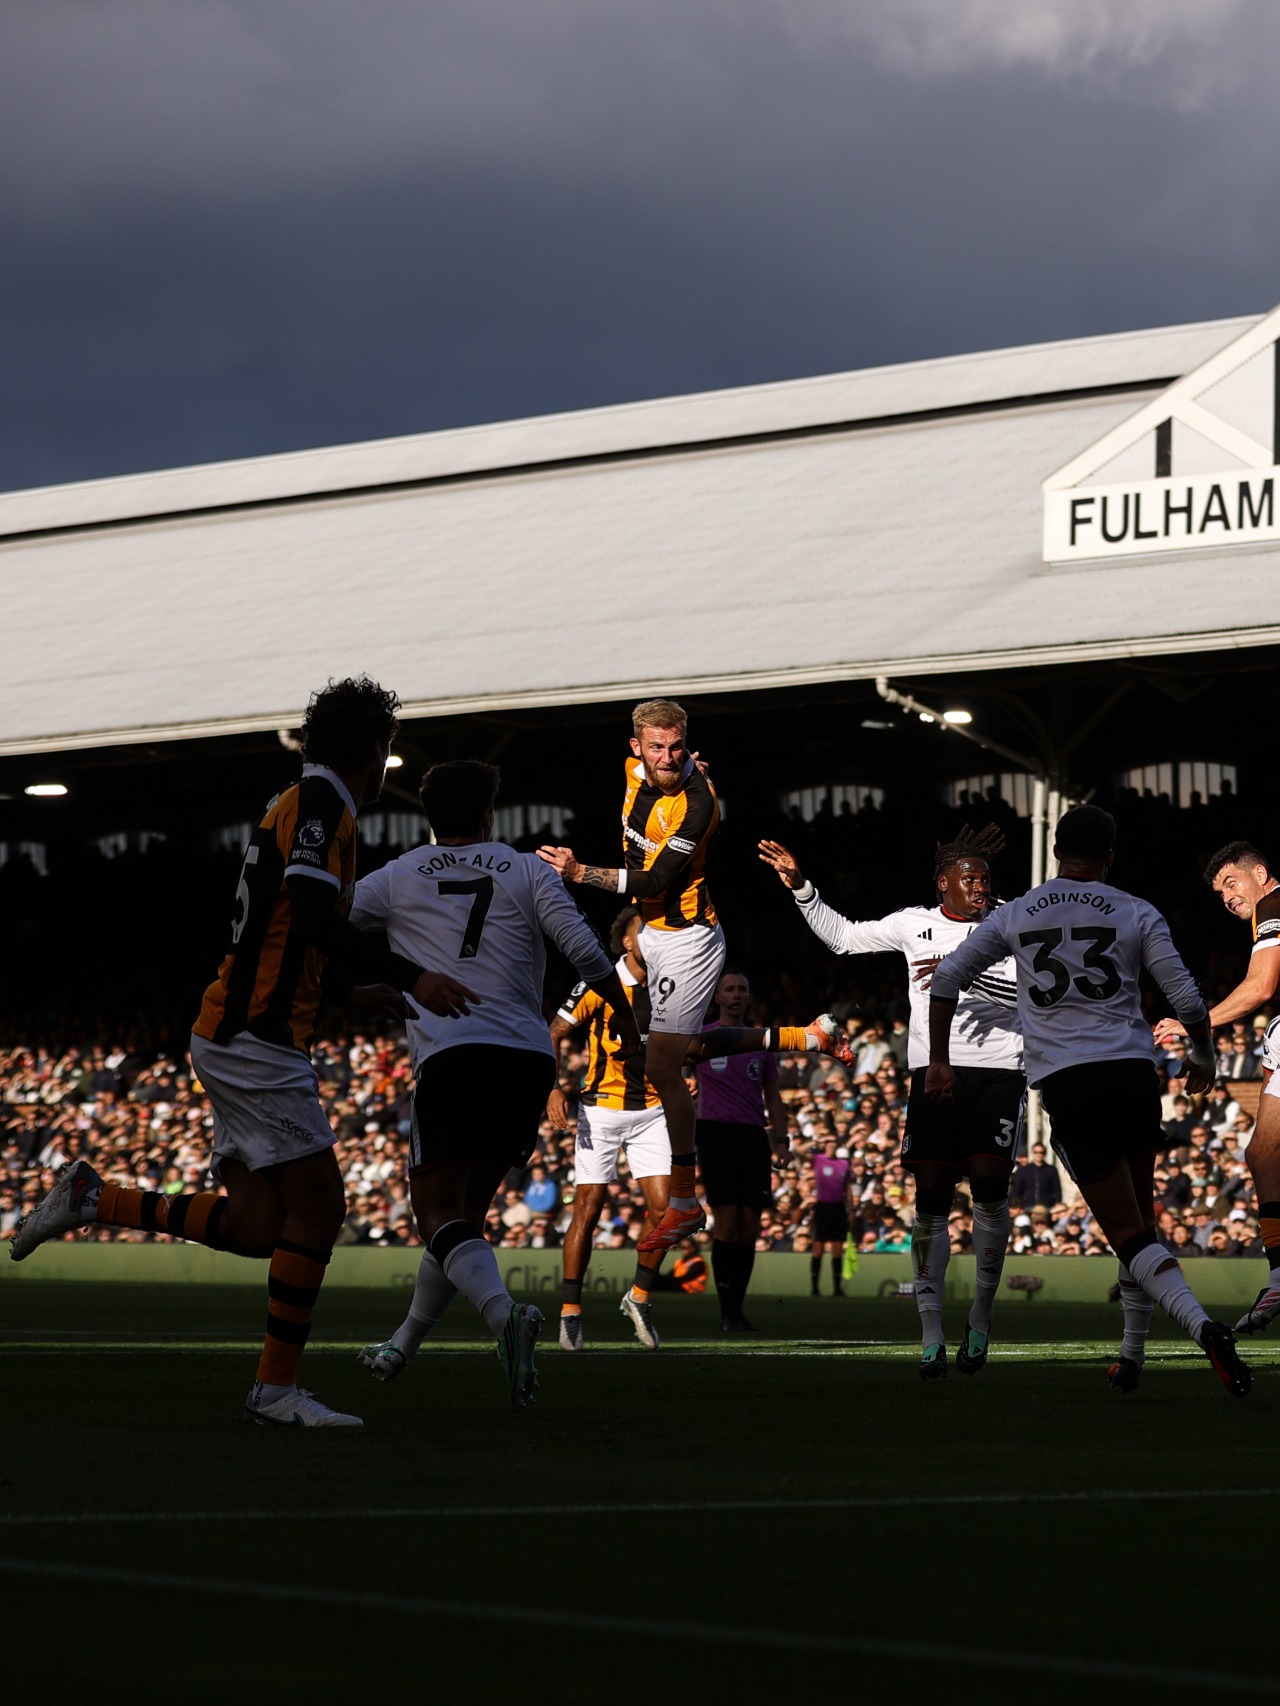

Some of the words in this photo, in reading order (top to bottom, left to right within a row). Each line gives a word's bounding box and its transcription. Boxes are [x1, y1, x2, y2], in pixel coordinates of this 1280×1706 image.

[1069, 478, 1275, 546] FULHAM
[438, 875, 494, 958] 7
[1026, 893, 1116, 916] ROBINSON
[659, 976, 675, 1005] 9
[1019, 926, 1122, 1007] 33
[995, 1118, 1014, 1148] 3
